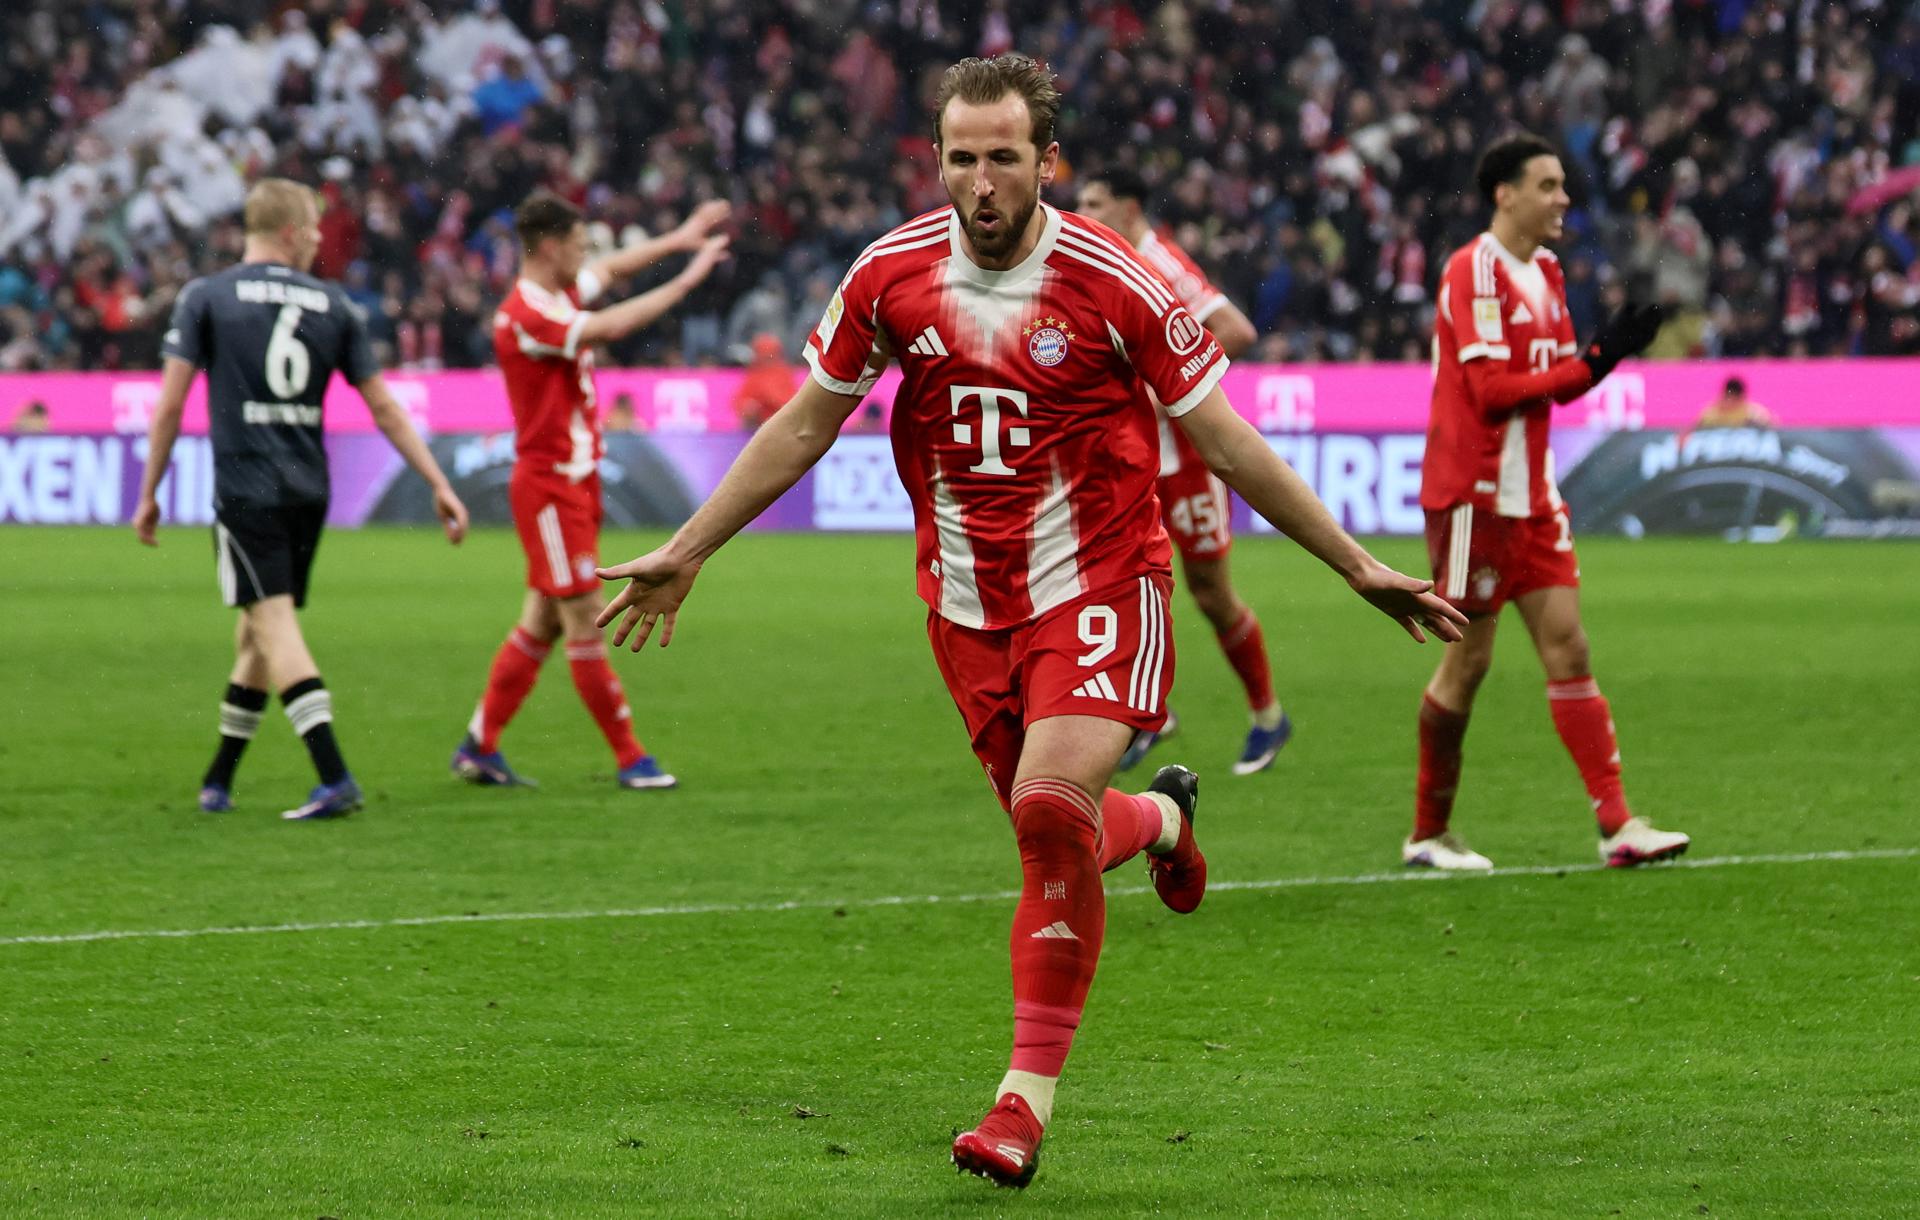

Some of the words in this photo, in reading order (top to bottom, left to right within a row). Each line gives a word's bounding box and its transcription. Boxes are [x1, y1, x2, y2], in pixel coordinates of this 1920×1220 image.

[265, 303, 310, 400] 6
[1041, 330, 1065, 346] BAYERN
[1180, 340, 1219, 382] Allianz
[950, 385, 1031, 476] T
[1170, 493, 1219, 536] 45
[1077, 605, 1118, 667] 9
